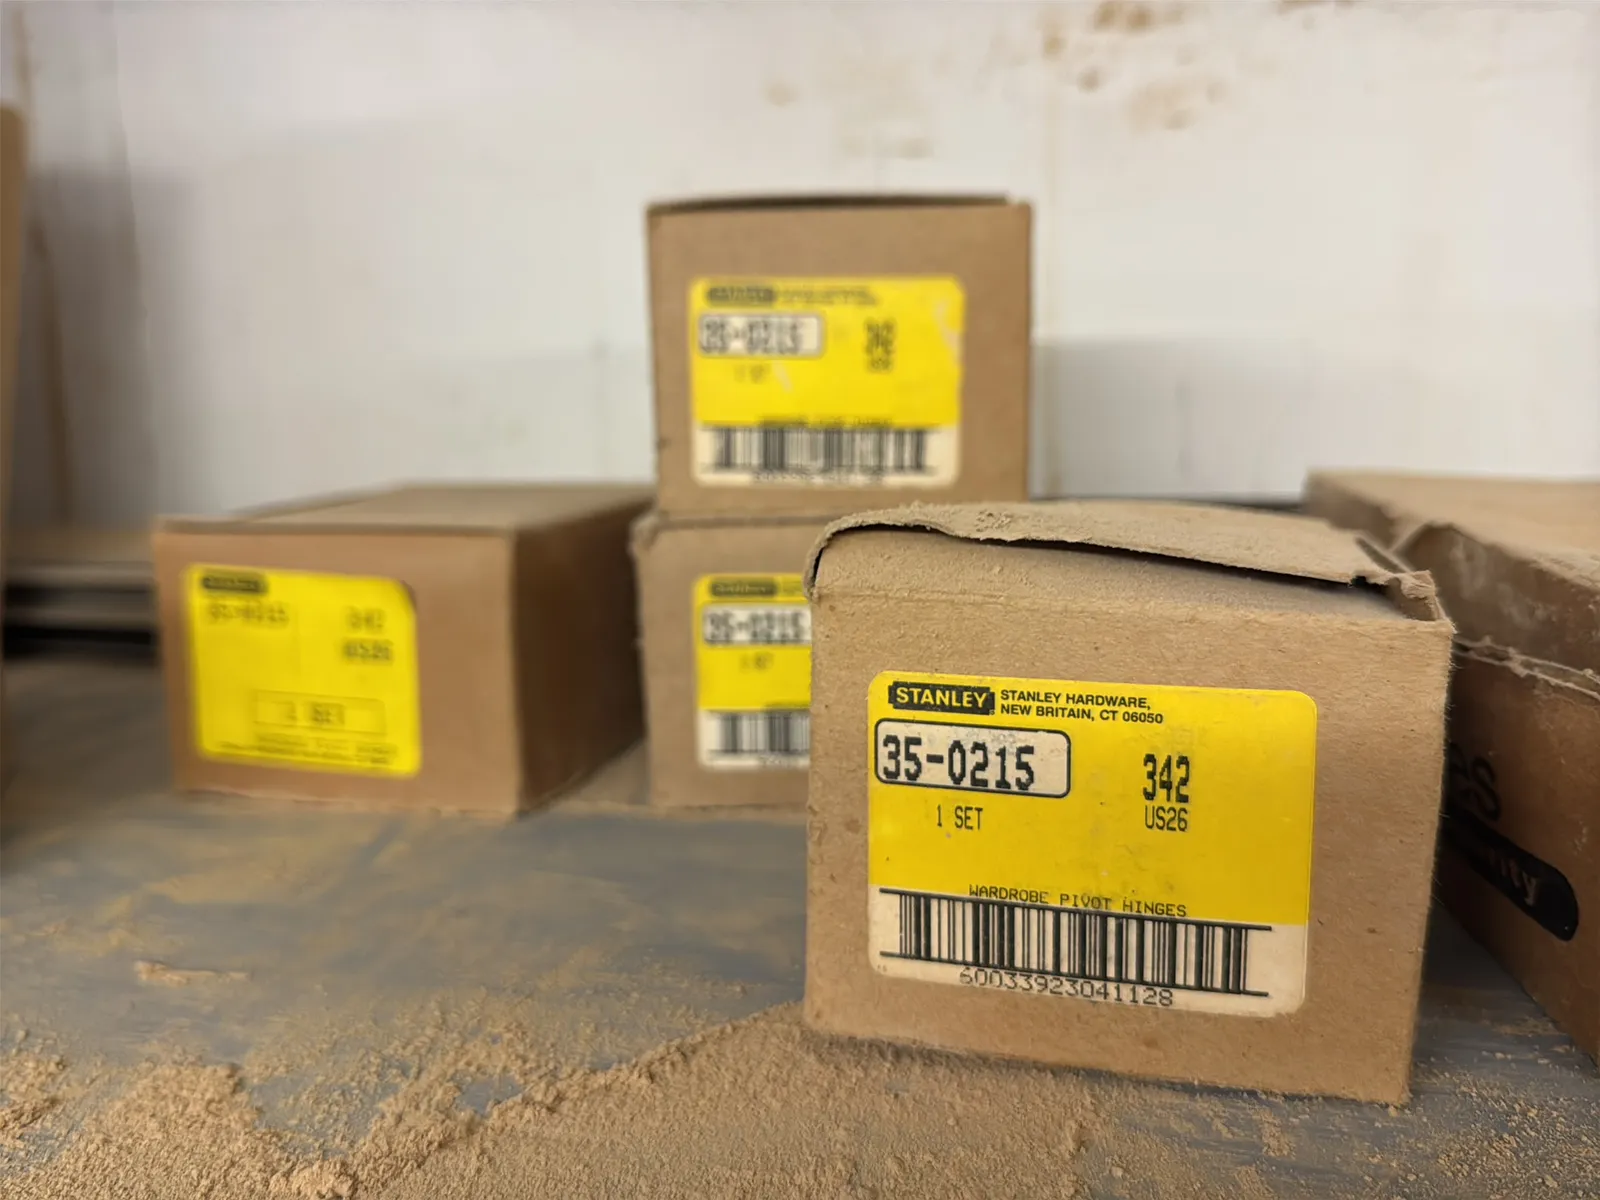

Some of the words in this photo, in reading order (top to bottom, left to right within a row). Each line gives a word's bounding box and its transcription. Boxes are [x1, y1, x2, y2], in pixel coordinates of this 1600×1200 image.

[896, 686, 987, 709] STANLEY
[1000, 689, 1062, 704] STANLEY
[1065, 694, 1151, 711] HARDWARE,
[1000, 703, 1032, 716] NEW
[1035, 706, 1095, 722] BRITAIN,
[1099, 709, 1119, 722] CT
[1122, 711, 1164, 724] 06050
[882, 734, 1035, 791] 35-0215
[1143, 753, 1190, 803] 342
[936, 803, 943, 828] 1
[954, 804, 984, 830] SET
[1144, 805, 1188, 832] US26
[968, 883, 1049, 904] WARDROBE
[1059, 893, 1113, 909] PIVOT
[1122, 900, 1188, 918] HINGES
[959, 966, 1175, 1007] 60033923041128
